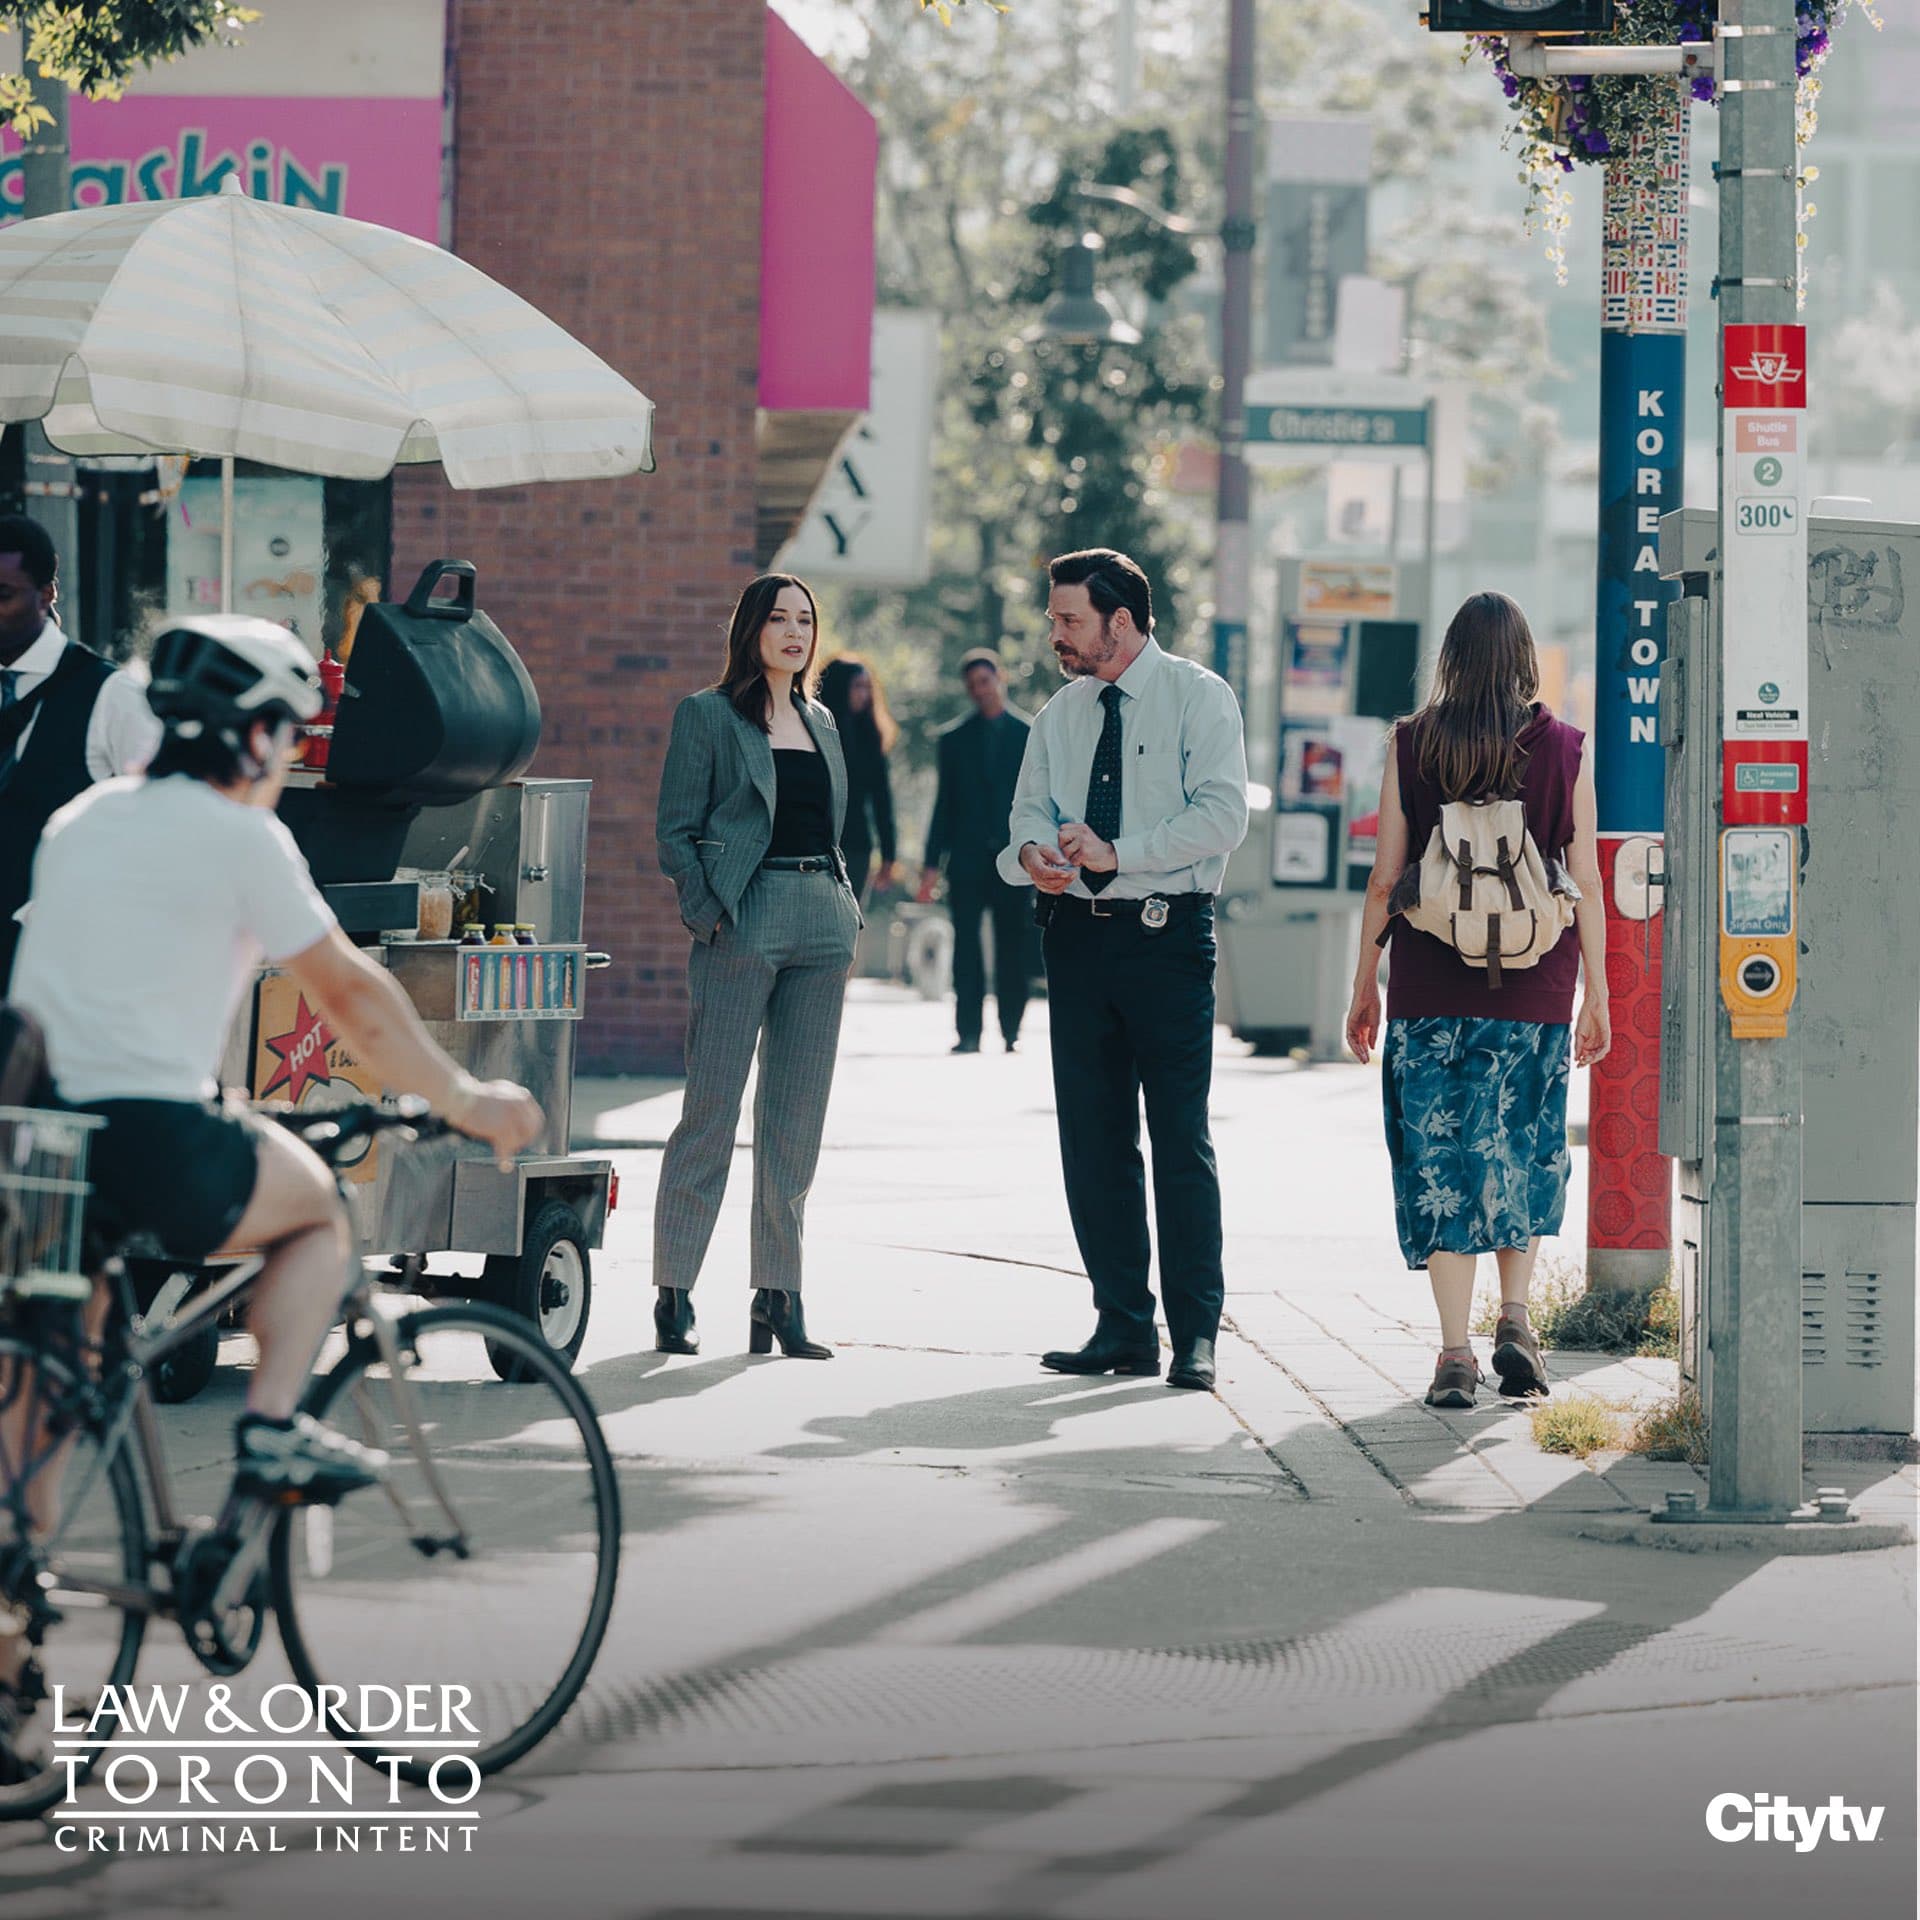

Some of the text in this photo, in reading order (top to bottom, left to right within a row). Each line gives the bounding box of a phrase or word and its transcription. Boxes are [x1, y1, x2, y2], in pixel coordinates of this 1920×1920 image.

[1268, 409, 1370, 441] Christie
[1756, 435, 1780, 447] Bus
[1761, 462, 1775, 481] 2
[1739, 505, 1781, 527] 300
[289, 1021, 323, 1073] HOT
